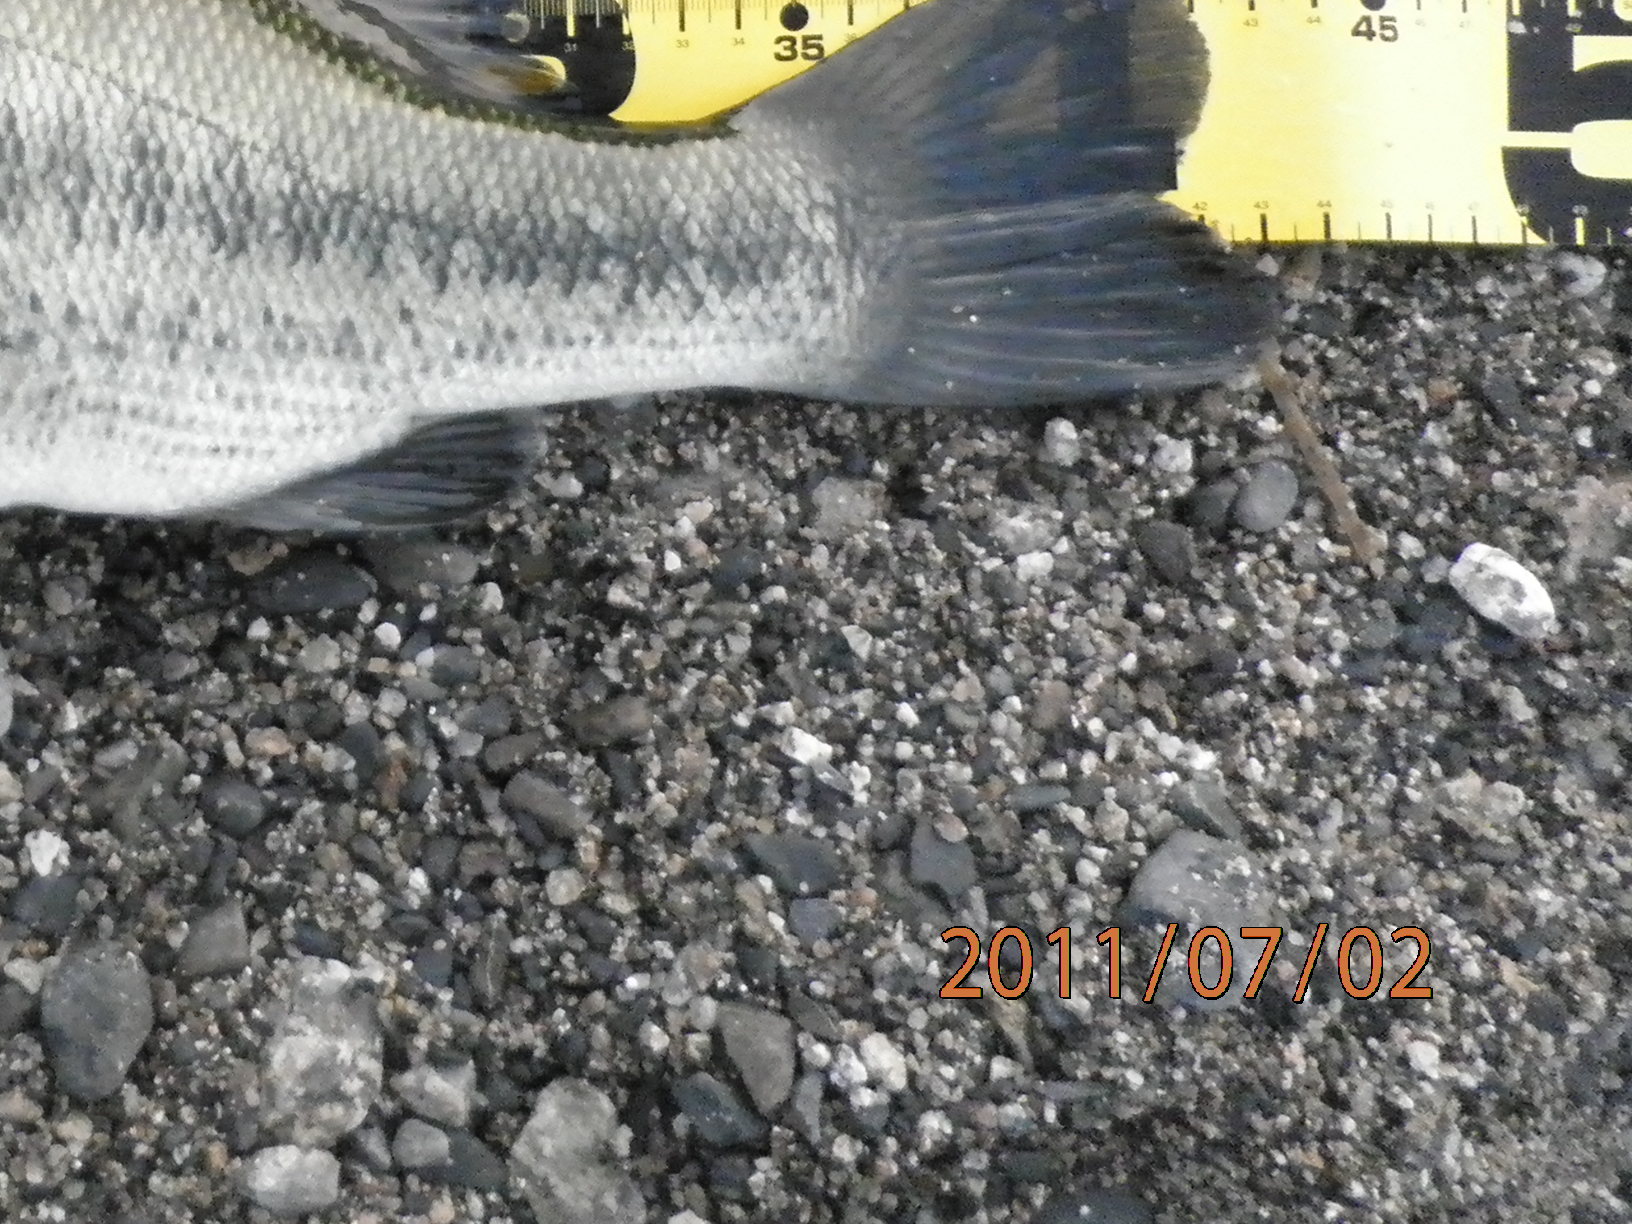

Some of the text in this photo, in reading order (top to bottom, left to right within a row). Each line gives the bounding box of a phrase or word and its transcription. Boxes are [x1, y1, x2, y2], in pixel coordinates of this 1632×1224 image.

[675, 39, 690, 49] 33
[731, 36, 745, 47] 34
[773, 33, 825, 61] 35
[1243, 17, 1259, 27] 43
[1350, 14, 1399, 43] 45
[1192, 201, 1208, 211] 42
[1253, 200, 1270, 210] 43
